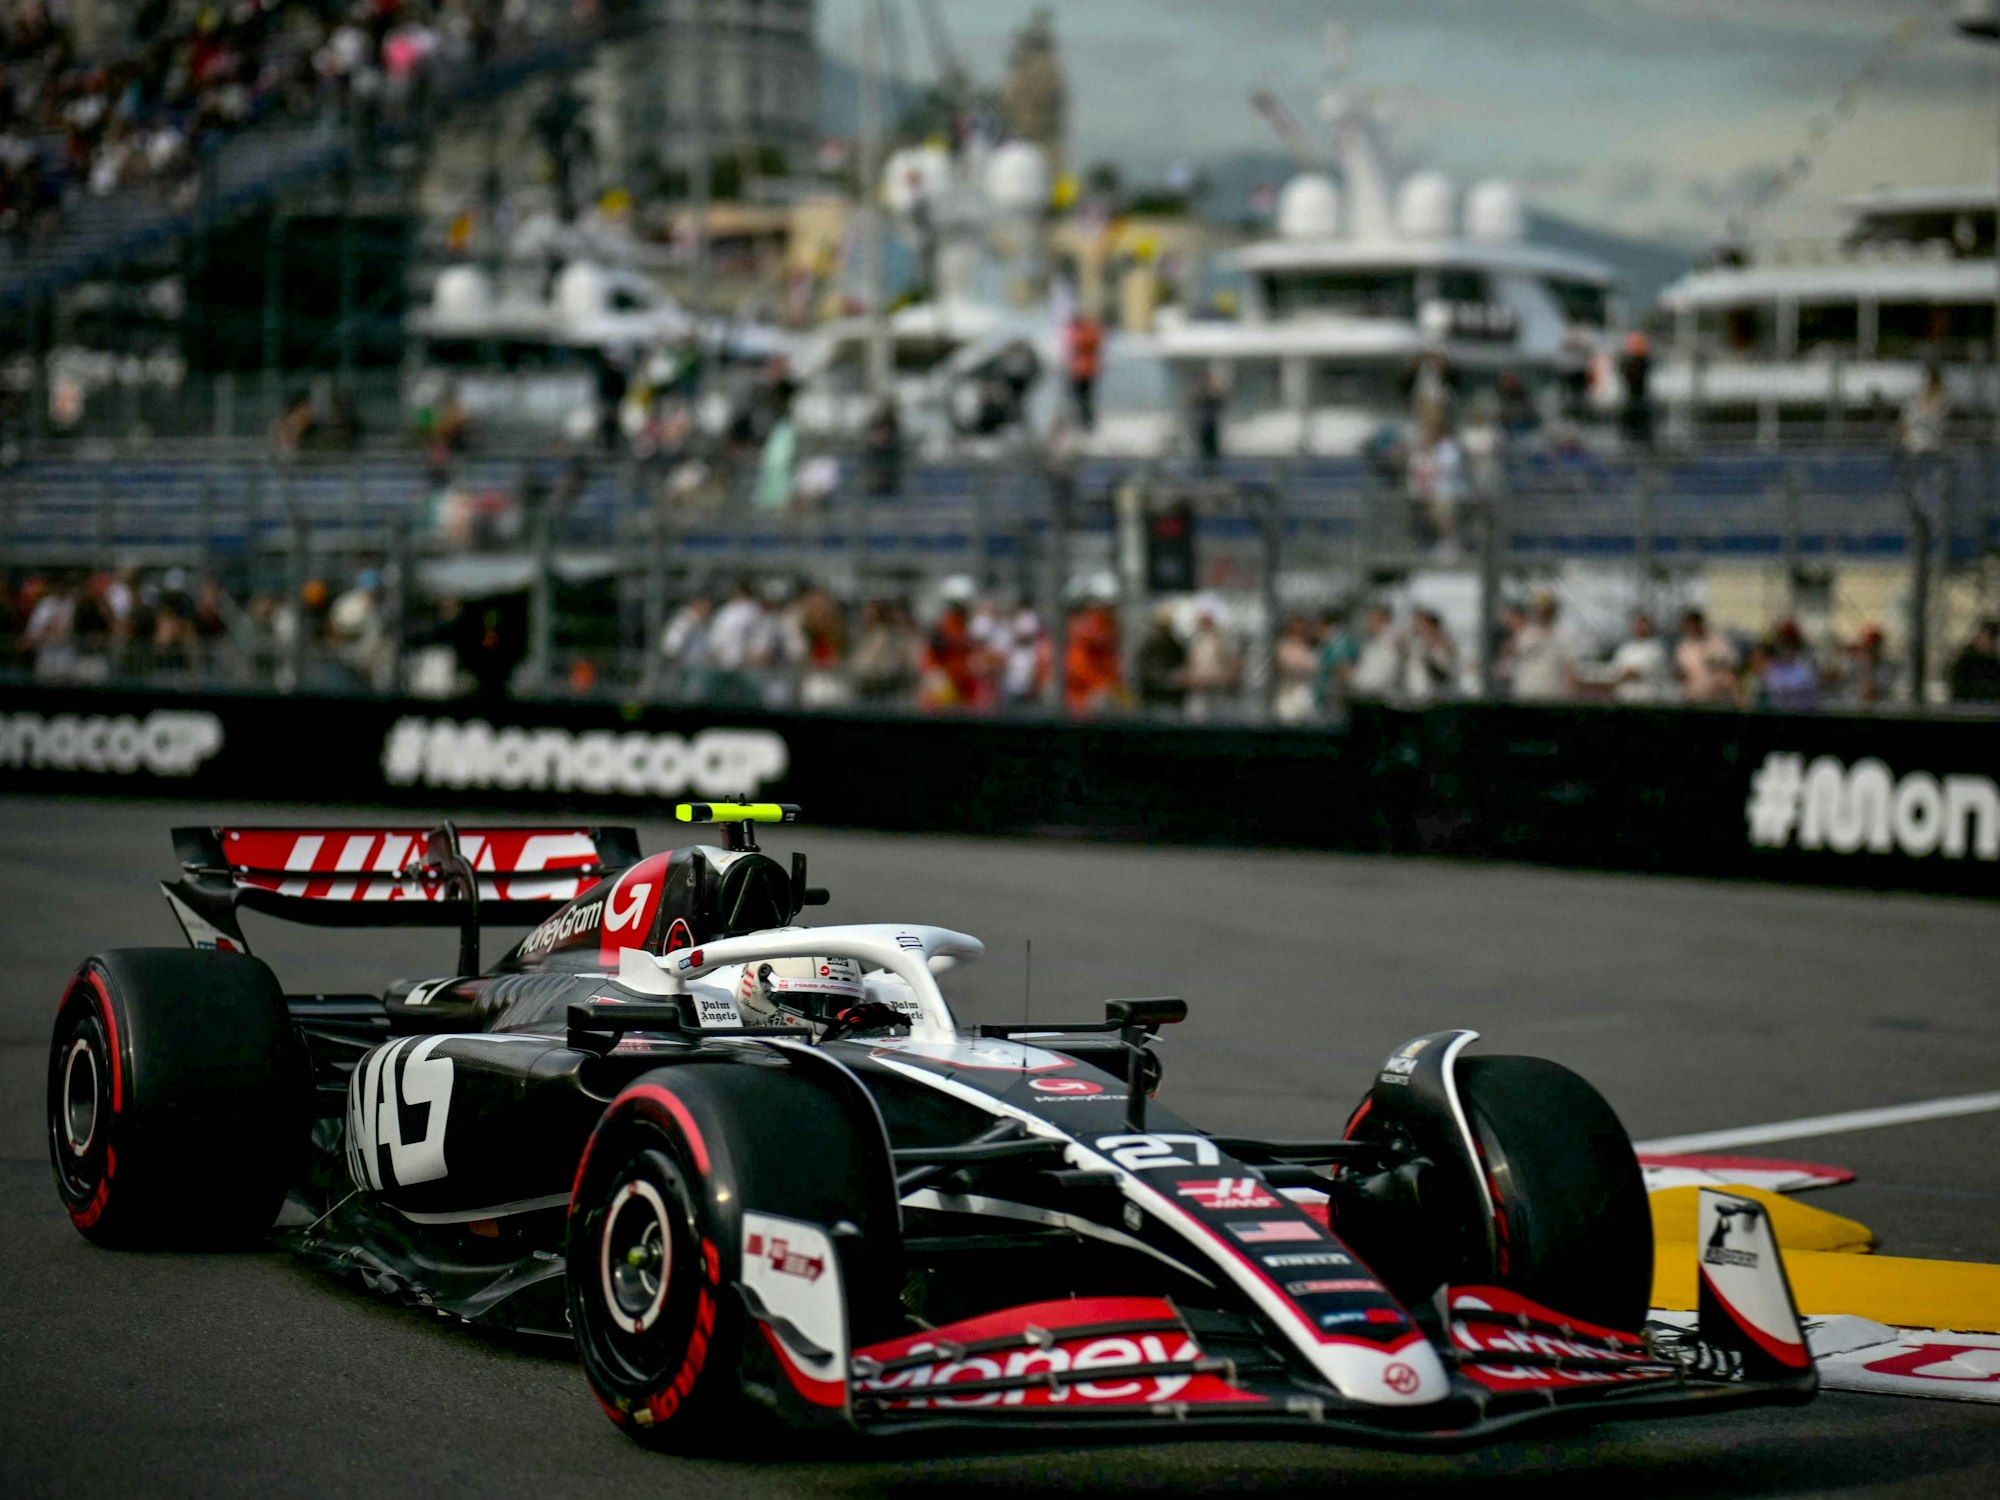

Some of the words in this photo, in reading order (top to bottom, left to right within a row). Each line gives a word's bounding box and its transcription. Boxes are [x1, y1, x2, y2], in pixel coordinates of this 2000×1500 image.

[383, 716, 788, 798] #MonacoGP
[516, 900, 603, 957] MoneyGram
[700, 1012, 737, 1022] Angels
[701, 1001, 729, 1011] Palm
[889, 1000, 919, 1011] Palm
[1095, 1133, 1220, 1171] 27
